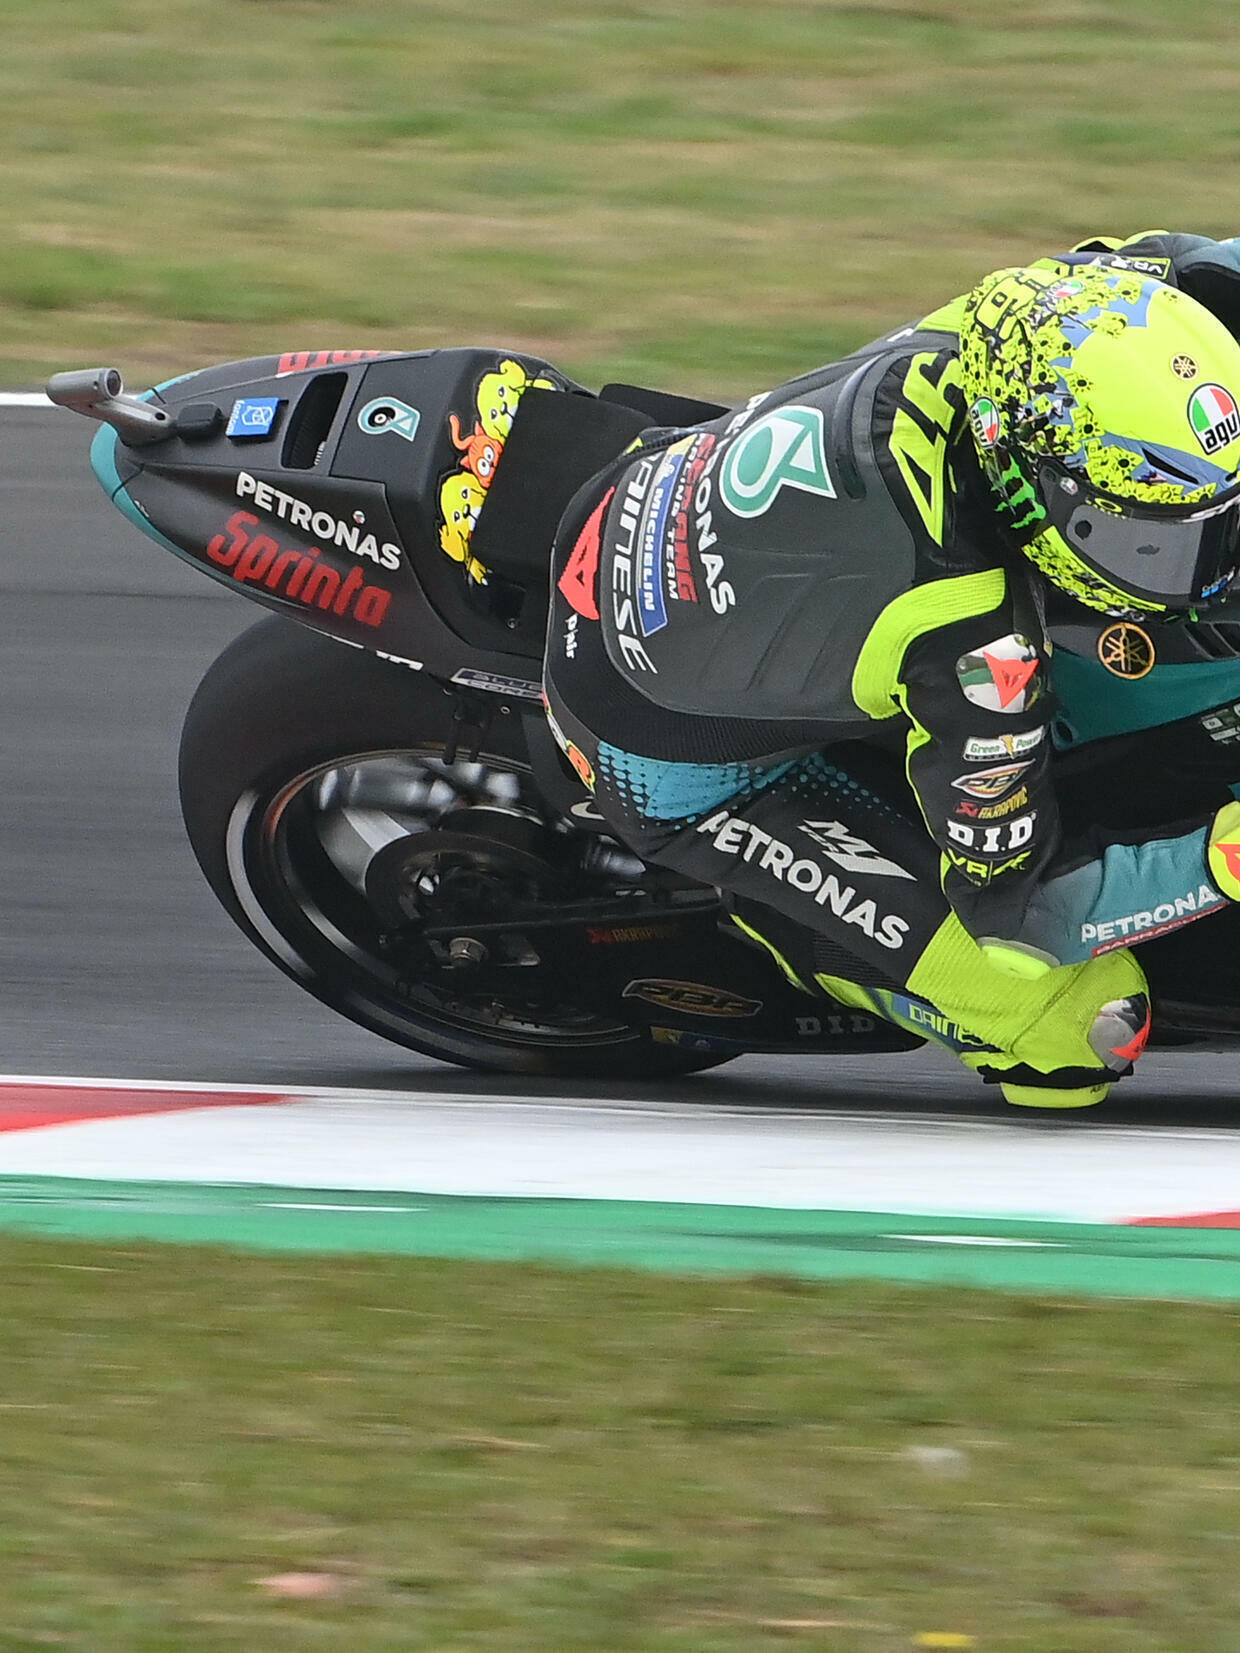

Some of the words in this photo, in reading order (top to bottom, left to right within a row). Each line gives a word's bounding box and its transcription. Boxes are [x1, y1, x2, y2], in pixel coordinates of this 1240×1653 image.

[1204, 414, 1238, 450] agv
[236, 471, 401, 570] PETRONAS
[613, 451, 664, 674] AINESE
[643, 488, 664, 611] MICHELIN
[666, 526, 680, 600] TEAM
[207, 510, 392, 627] Sprinta
[970, 743, 1000, 754] Green
[1081, 884, 1222, 943] PETRONA
